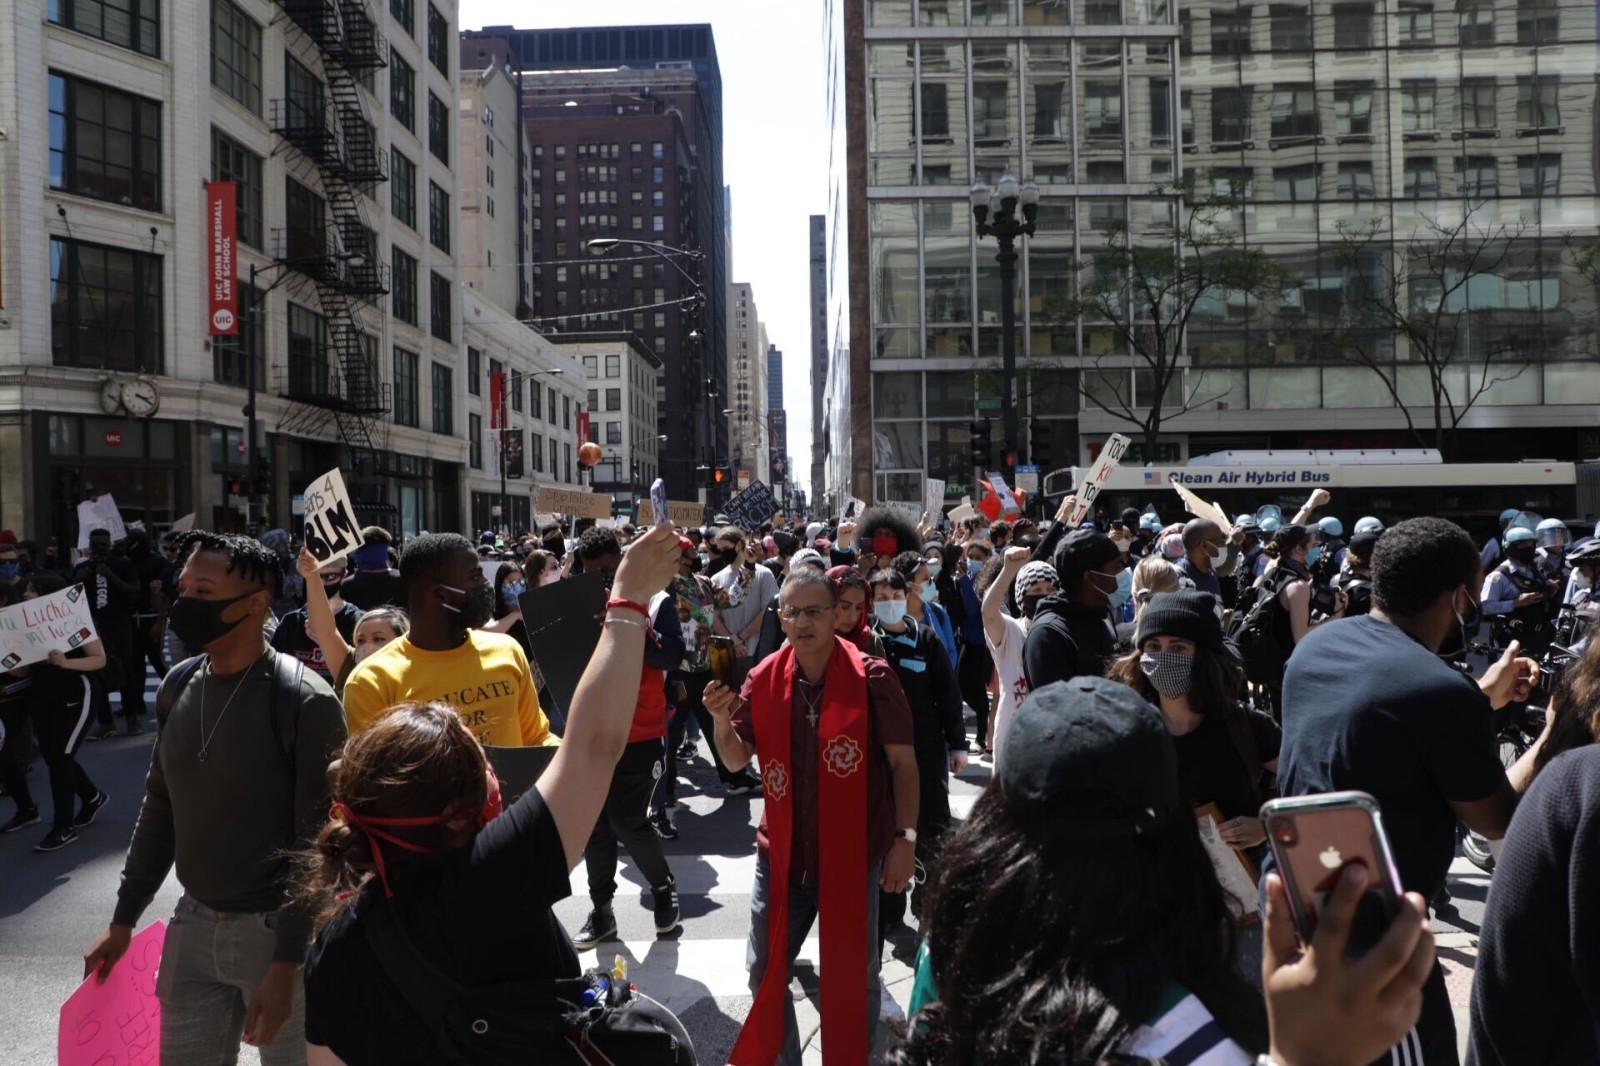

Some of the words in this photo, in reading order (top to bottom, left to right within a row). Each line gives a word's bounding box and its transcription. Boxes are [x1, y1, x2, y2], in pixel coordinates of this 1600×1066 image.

[215, 316, 231, 324] UIC
[1168, 472, 1212, 483] Clean
[1218, 472, 1240, 483] Air
[1245, 471, 1296, 485] Hybrid
[1301, 471, 1330, 482] Bus
[324, 475, 336, 502] 4
[946, 484, 966, 494] ATM
[1084, 482, 1100, 501] TO
[732, 494, 780, 533] RACISM
[305, 499, 362, 562] BLM
[22, 600, 75, 627] Lucha
[25, 626, 47, 646] mi
